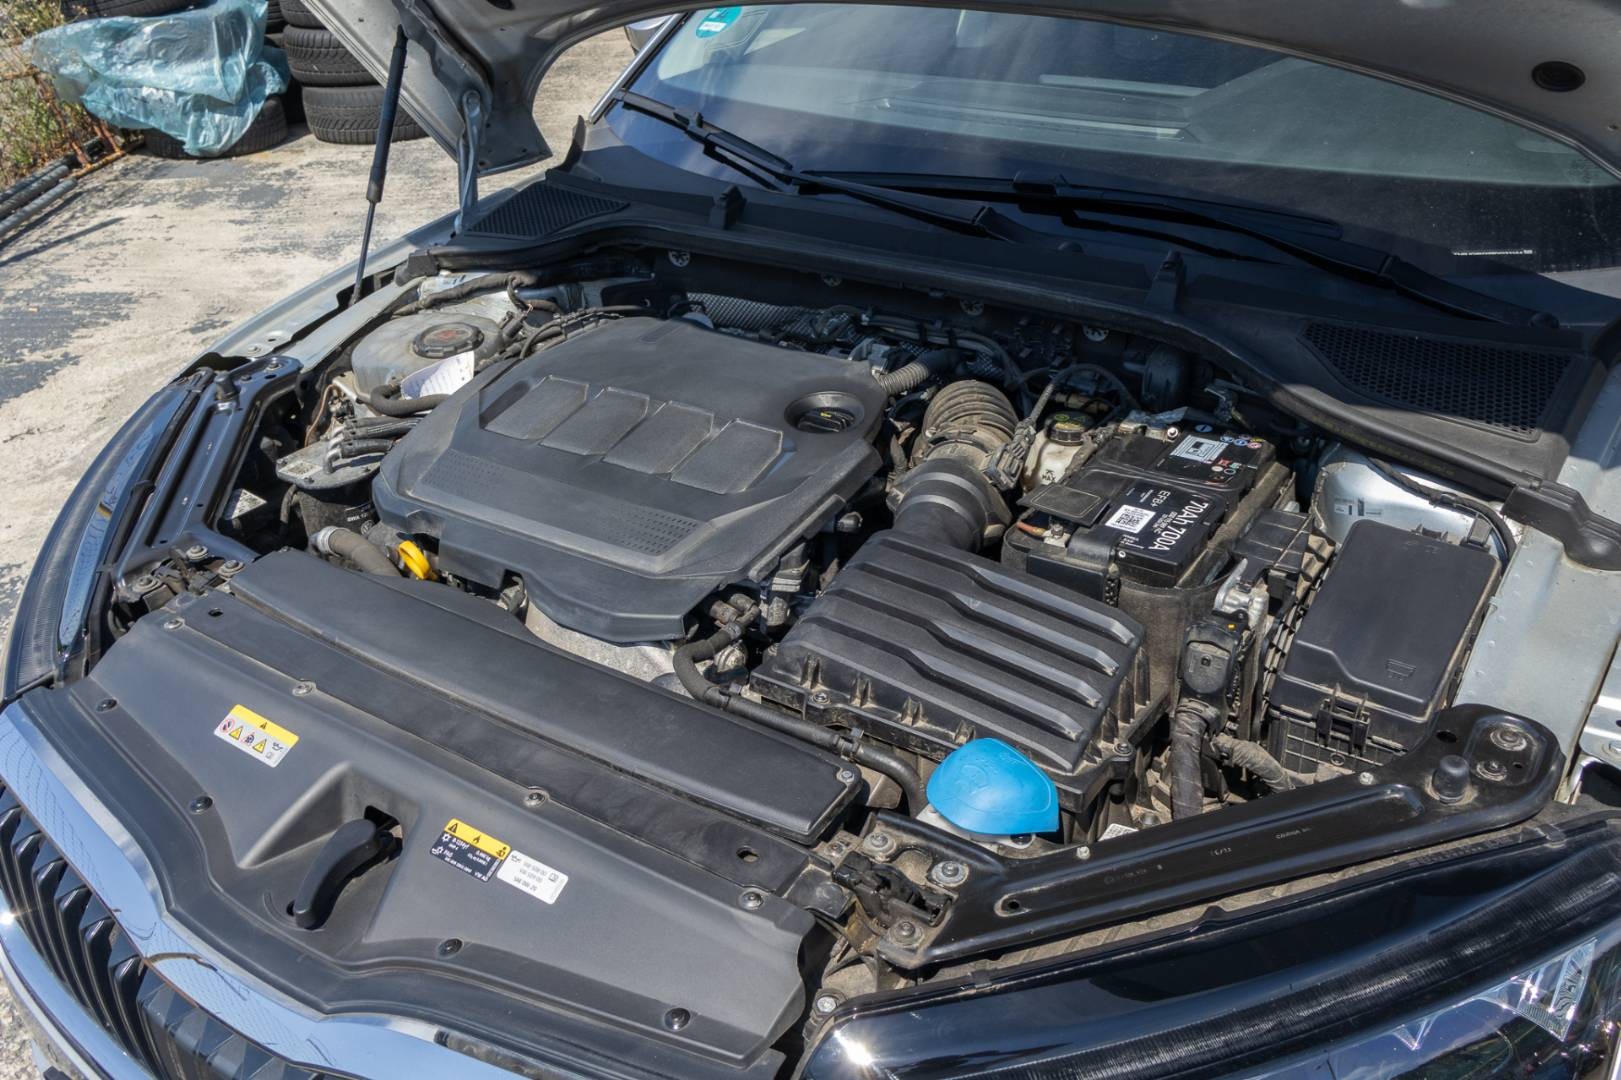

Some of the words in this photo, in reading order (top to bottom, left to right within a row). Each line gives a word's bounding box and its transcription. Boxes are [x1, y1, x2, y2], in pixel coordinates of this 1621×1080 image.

[1042, 474, 1056, 482] MAX
[1150, 490, 1171, 507] EFB+
[1172, 500, 1209, 525] 70Ah
[1148, 525, 1187, 551] 700A
